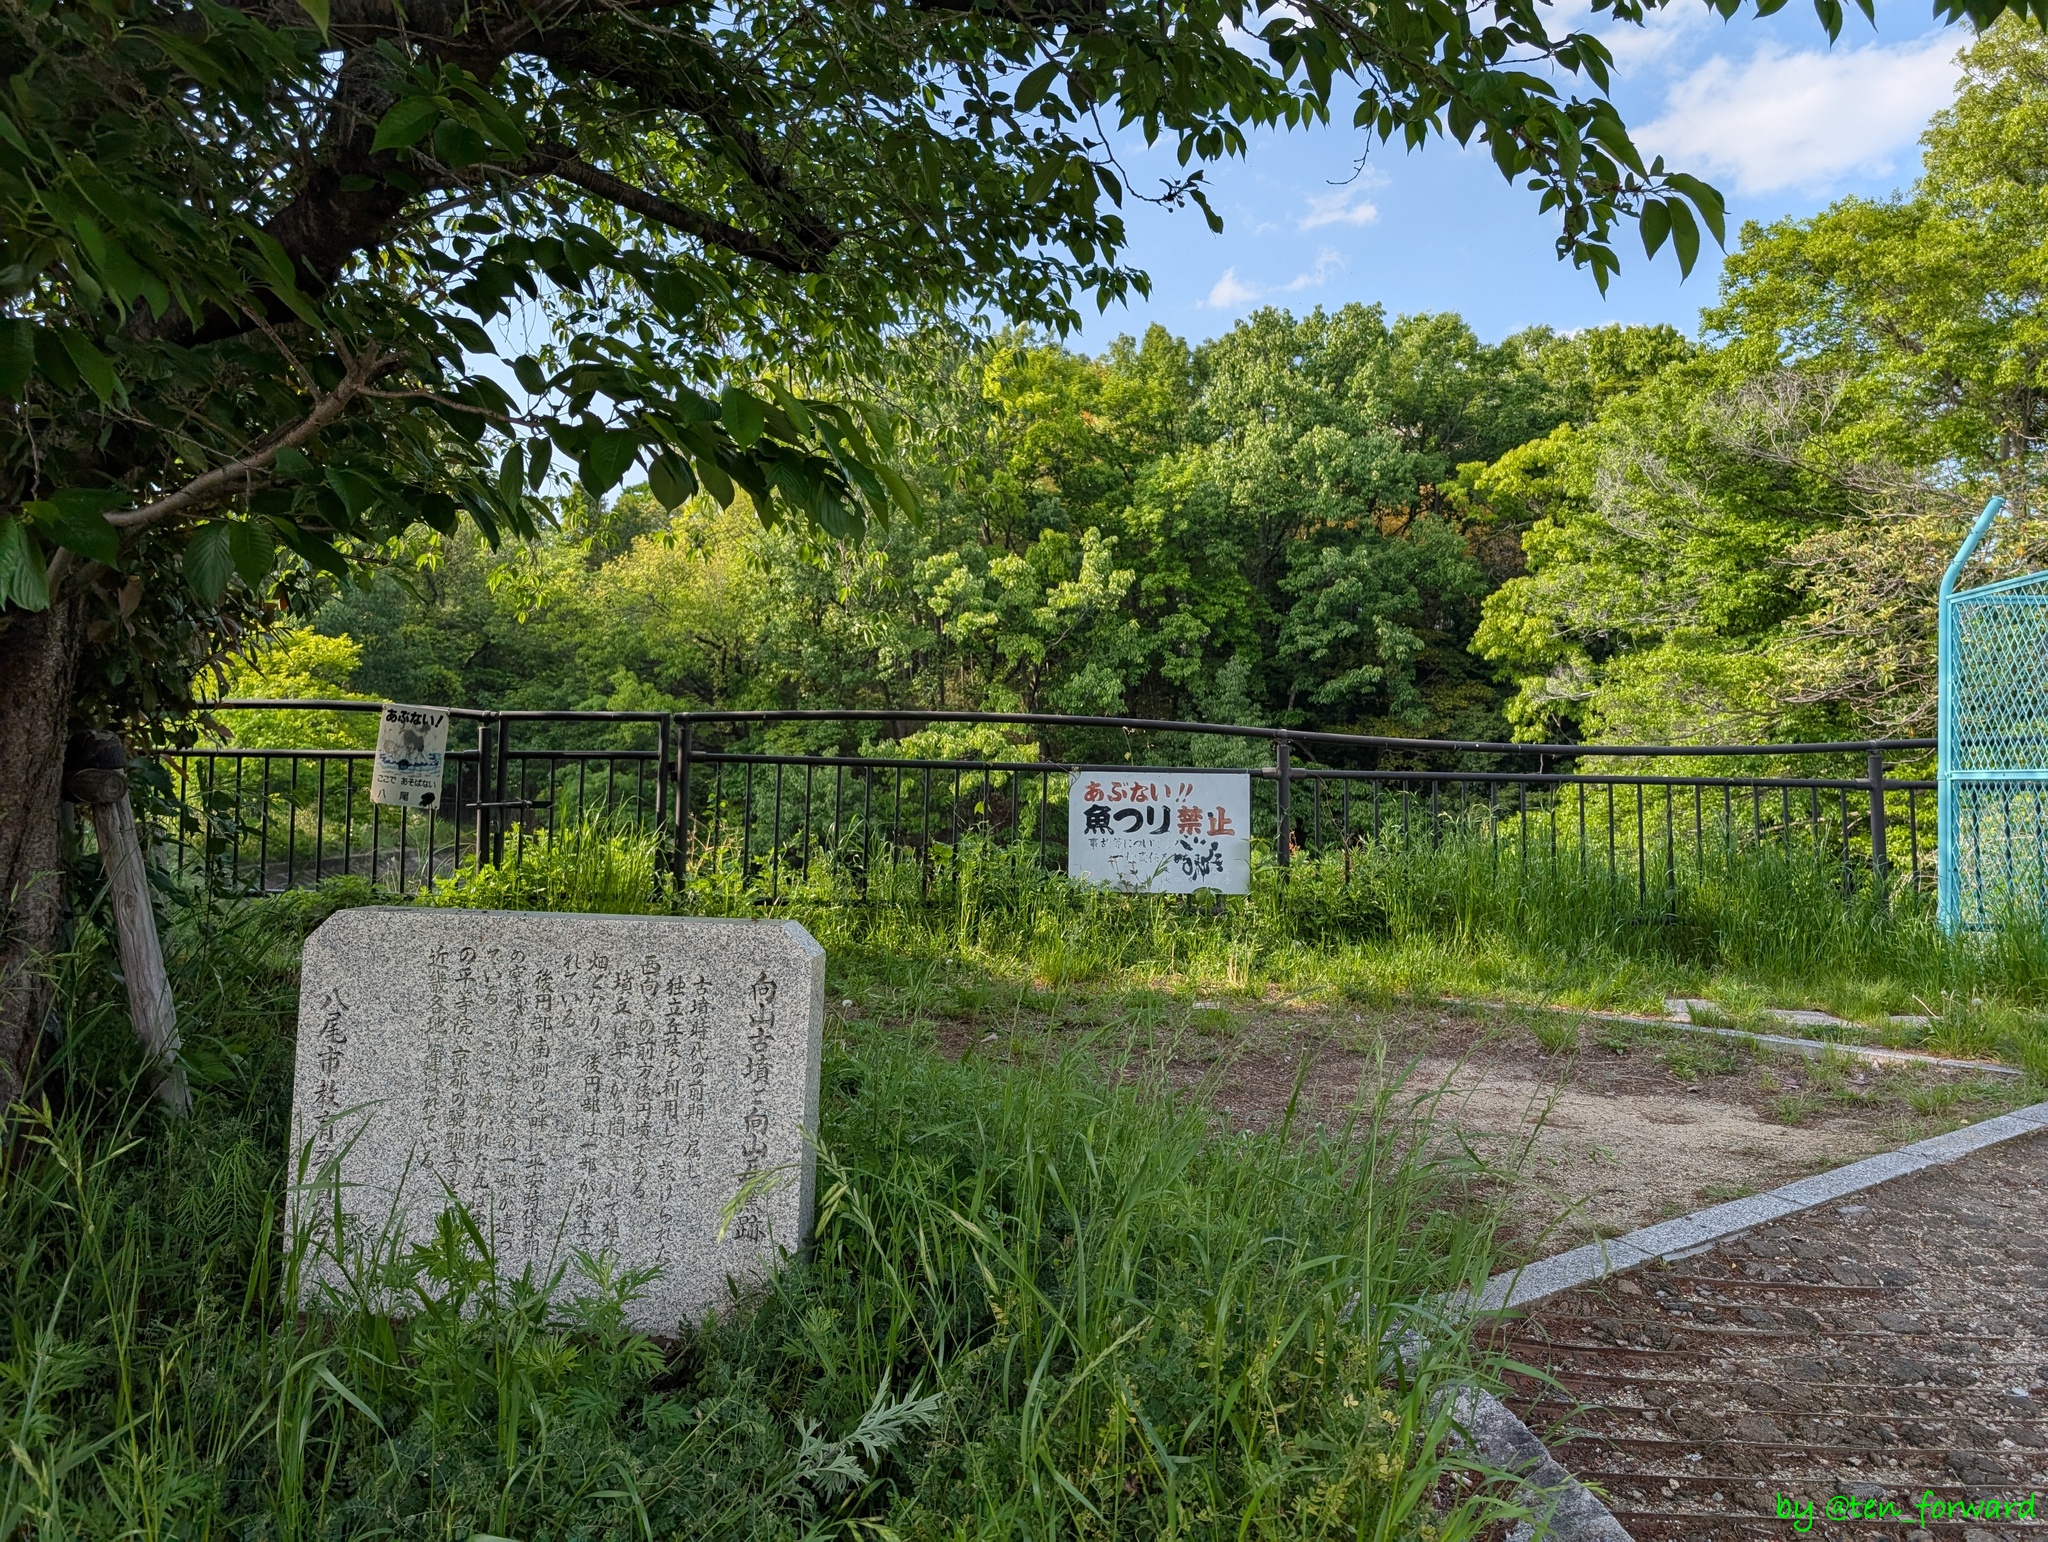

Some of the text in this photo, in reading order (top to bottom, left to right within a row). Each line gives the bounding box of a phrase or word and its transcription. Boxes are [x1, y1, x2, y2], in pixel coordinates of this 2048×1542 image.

[386, 708, 444, 728] あぶない!
[377, 774, 436, 789] ここで あそばない
[1083, 780, 1194, 803] あぶない!!
[1083, 803, 1236, 837] 魚つり禁止
